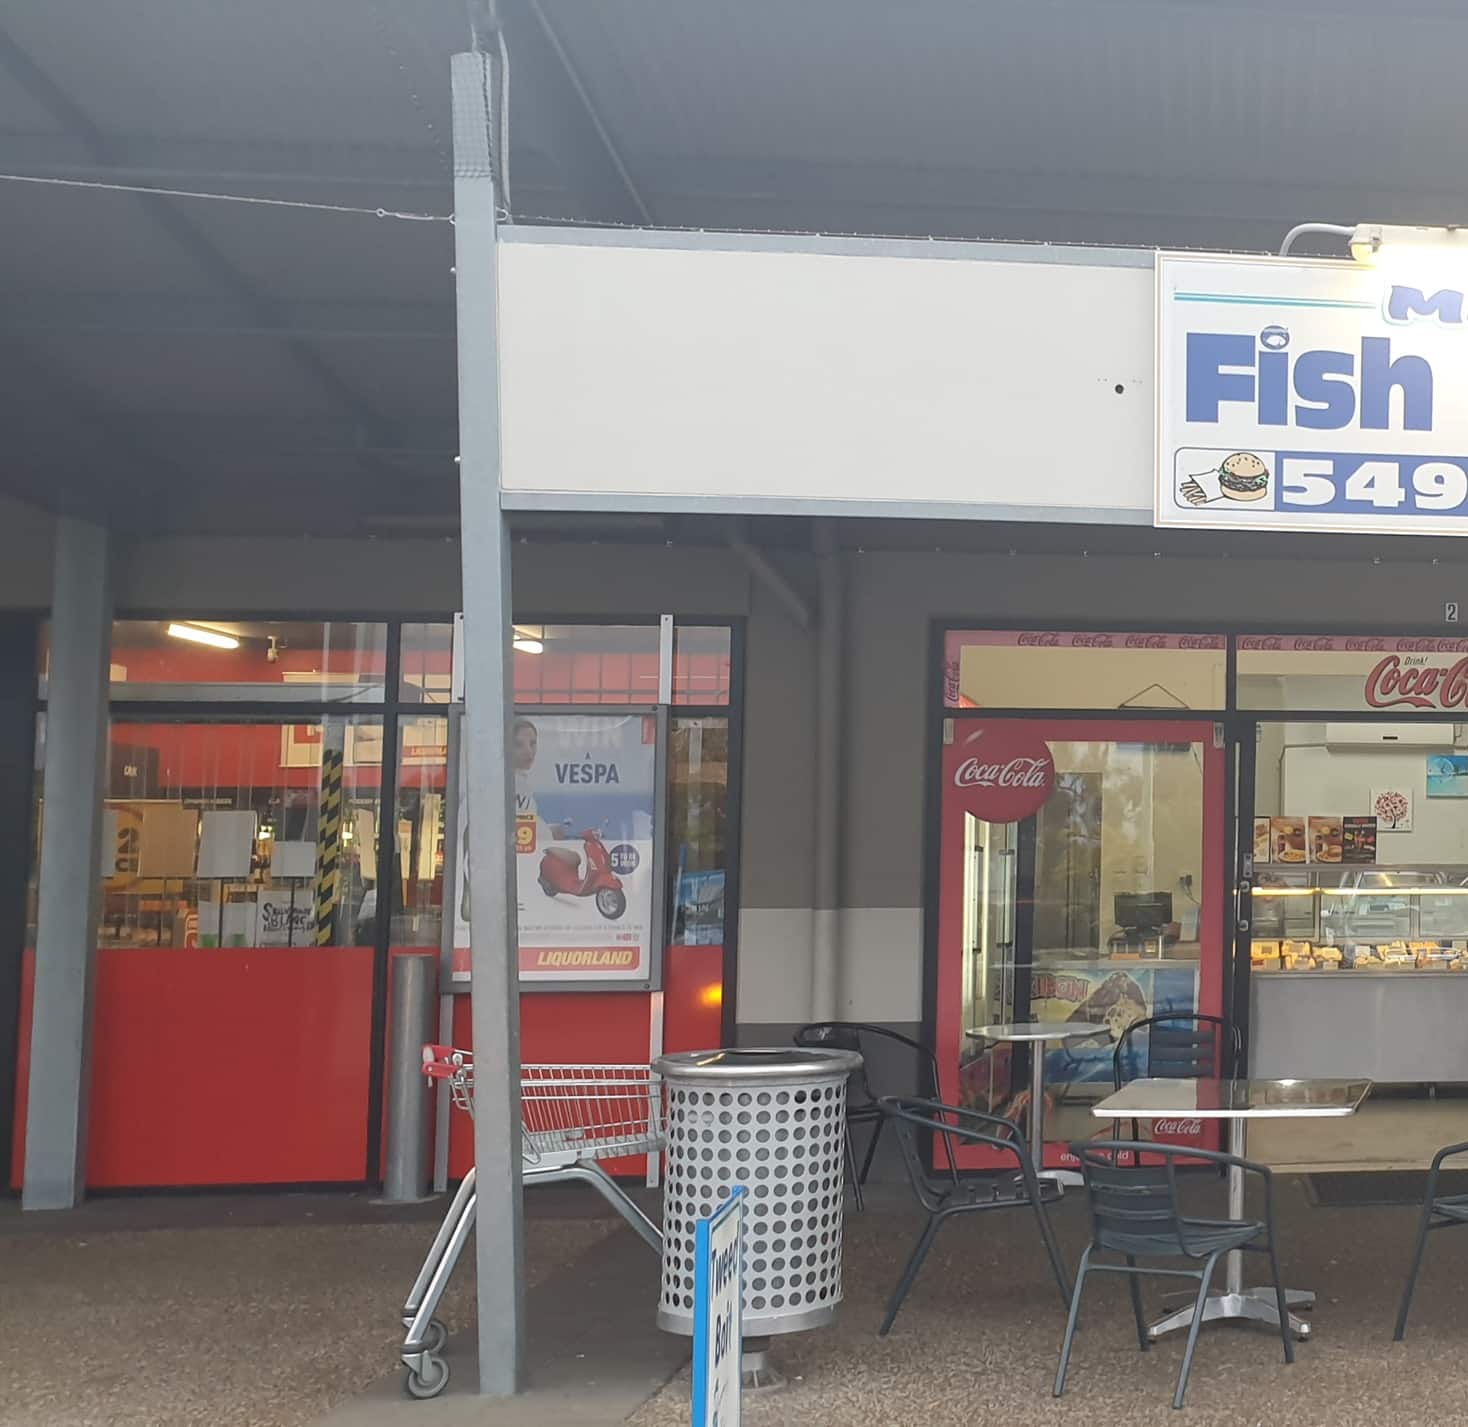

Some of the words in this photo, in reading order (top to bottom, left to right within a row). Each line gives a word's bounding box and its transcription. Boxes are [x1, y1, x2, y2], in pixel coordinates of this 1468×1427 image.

[1186, 325, 1434, 431] Fish
[1447, 604, 1456, 621] 2
[1404, 656, 1428, 666] Drink!
[555, 763, 620, 785] VESPA
[611, 853, 620, 868] 5
[537, 951, 633, 967] LIQUORLAND
[1107, 1151, 1129, 1161] cld
[711, 1221, 740, 1297] Tweed
